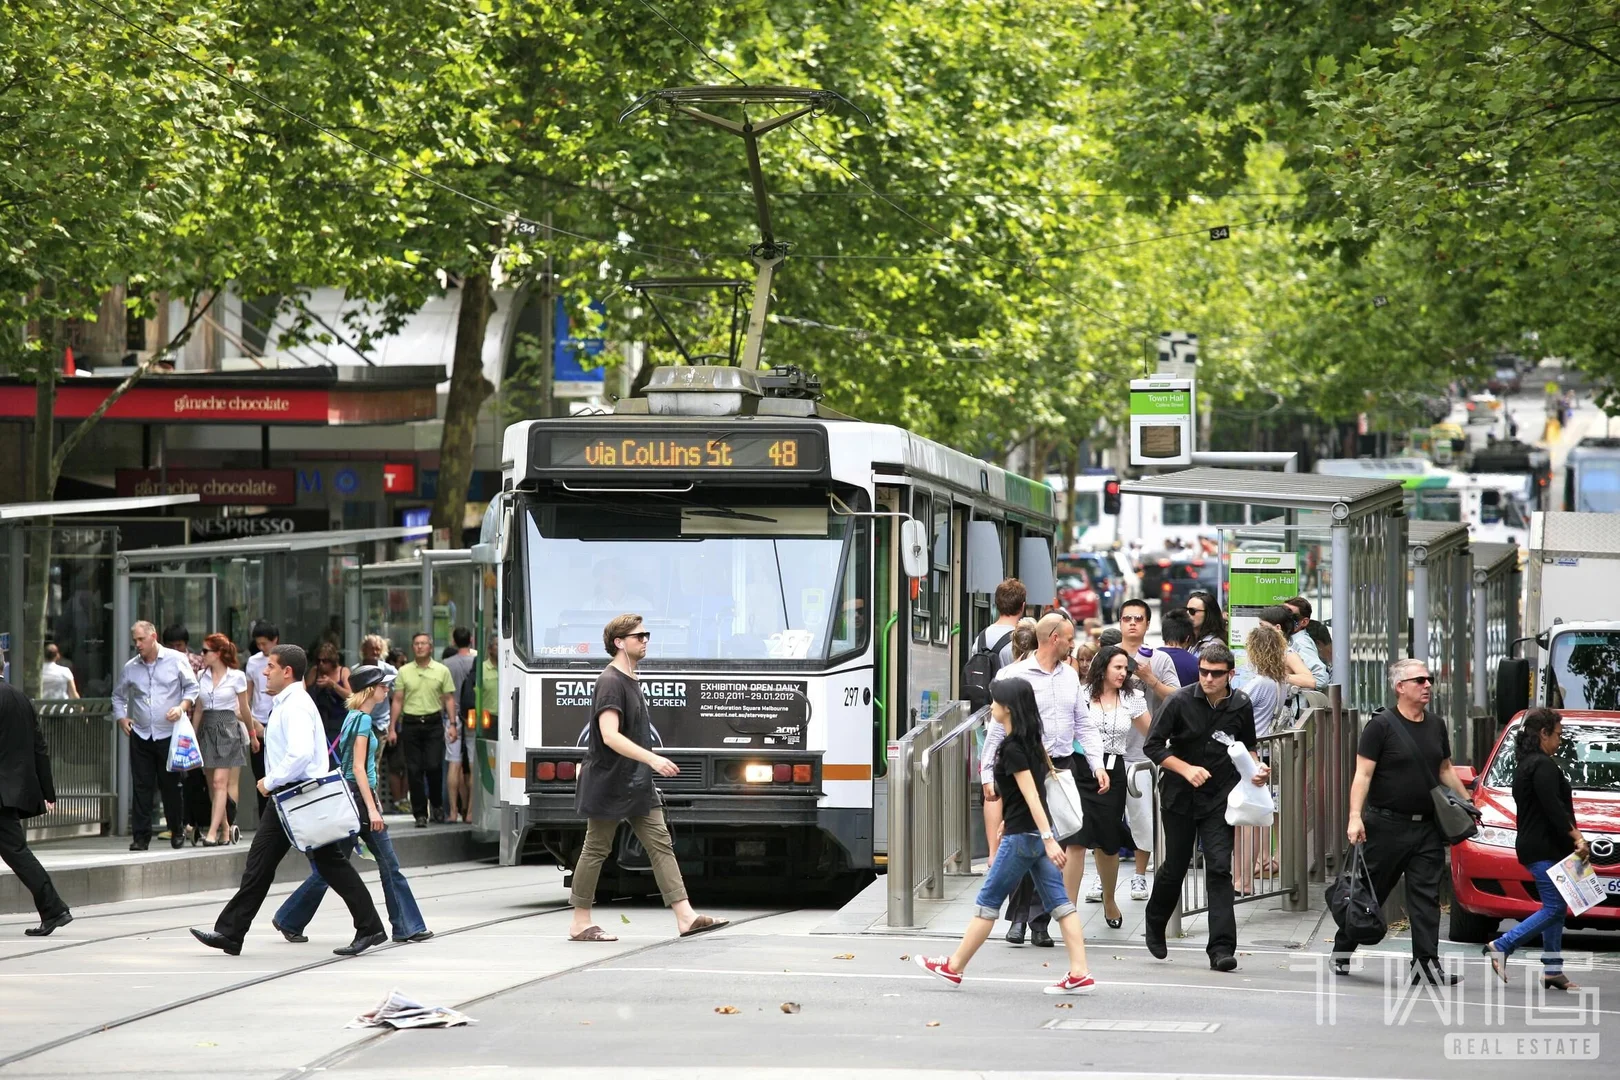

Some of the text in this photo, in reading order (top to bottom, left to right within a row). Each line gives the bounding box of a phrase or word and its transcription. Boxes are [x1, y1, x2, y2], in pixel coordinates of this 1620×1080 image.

[519, 222, 536, 234] 34
[1211, 227, 1228, 239] 34
[228, 396, 290, 411] chocolate
[1147, 394, 1184, 402] Town Hall
[585, 440, 796, 466] via Collins St 48
[202, 479, 277, 496] chocolate
[191, 517, 295, 534] NESPRESSO
[1254, 576, 1295, 584] Town Hall
[540, 645, 577, 655] metlink
[639, 682, 687, 697] AGER
[700, 683, 800, 692] EXHIBITION OPEN DAILY
[652, 698, 687, 707] SCREEN
[844, 687, 859, 707] 297
[775, 724, 800, 734] acmi
